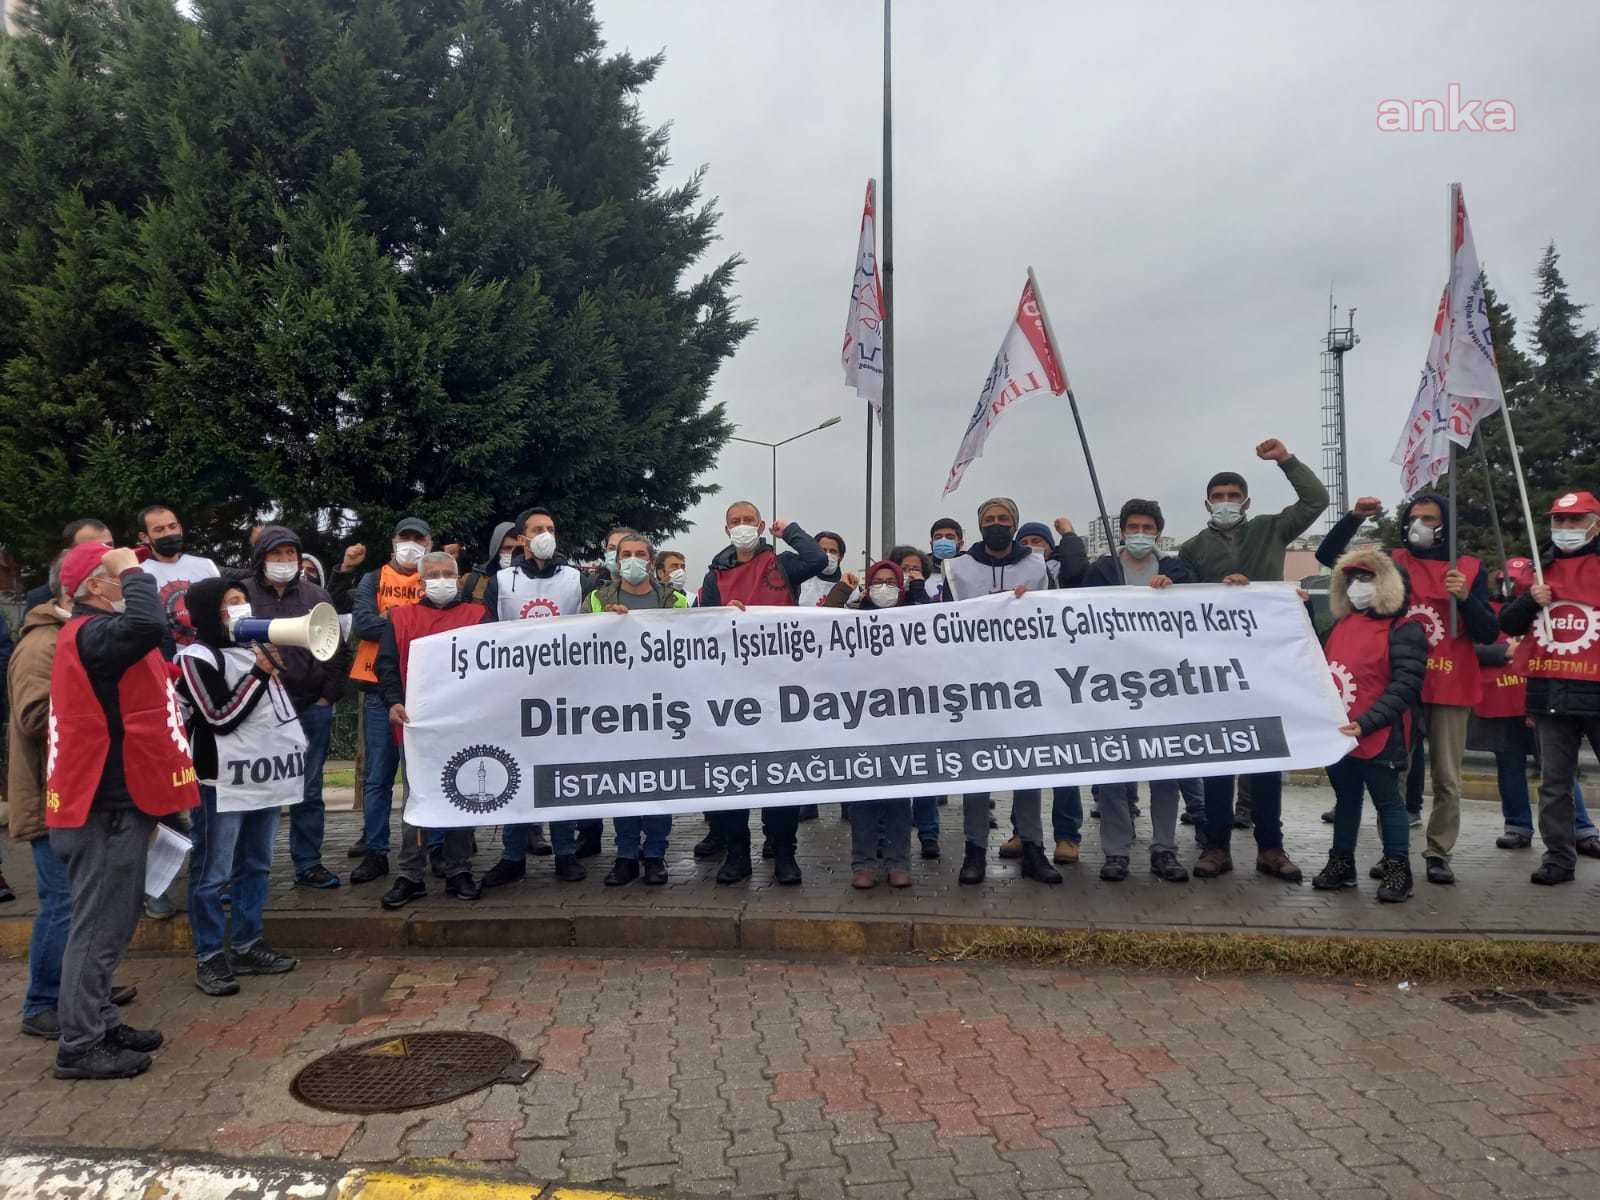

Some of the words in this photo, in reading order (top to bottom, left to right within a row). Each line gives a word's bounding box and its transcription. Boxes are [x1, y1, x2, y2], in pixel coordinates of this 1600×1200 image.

[450, 636, 469, 679] İş
[475, 633, 634, 675] Cinayetlerine,
[641, 630, 727, 669] Salgına,
[731, 620, 823, 666] İşsizliğe,
[829, 615, 895, 658] Açlığa
[900, 622, 927, 647] ve
[933, 606, 1058, 644] Güvencesiz
[1062, 603, 1198, 644] Çalıştırmaya
[1202, 602, 1258, 641] Karşı
[521, 693, 692, 741] Direniş
[706, 698, 762, 728] ve
[779, 680, 1043, 729] Dayanışma
[1055, 658, 1250, 710] Yaşatır!
[555, 770, 696, 798] İSTANBUL
[705, 760, 758, 794] İŞÇİ
[767, 752, 882, 784] SAĞLIĞI
[890, 755, 929, 777] VE
[936, 749, 963, 779] İŞ
[972, 733, 1130, 773] GÜVENLİĞİ
[1137, 724, 1262, 761] MECLİSİ
